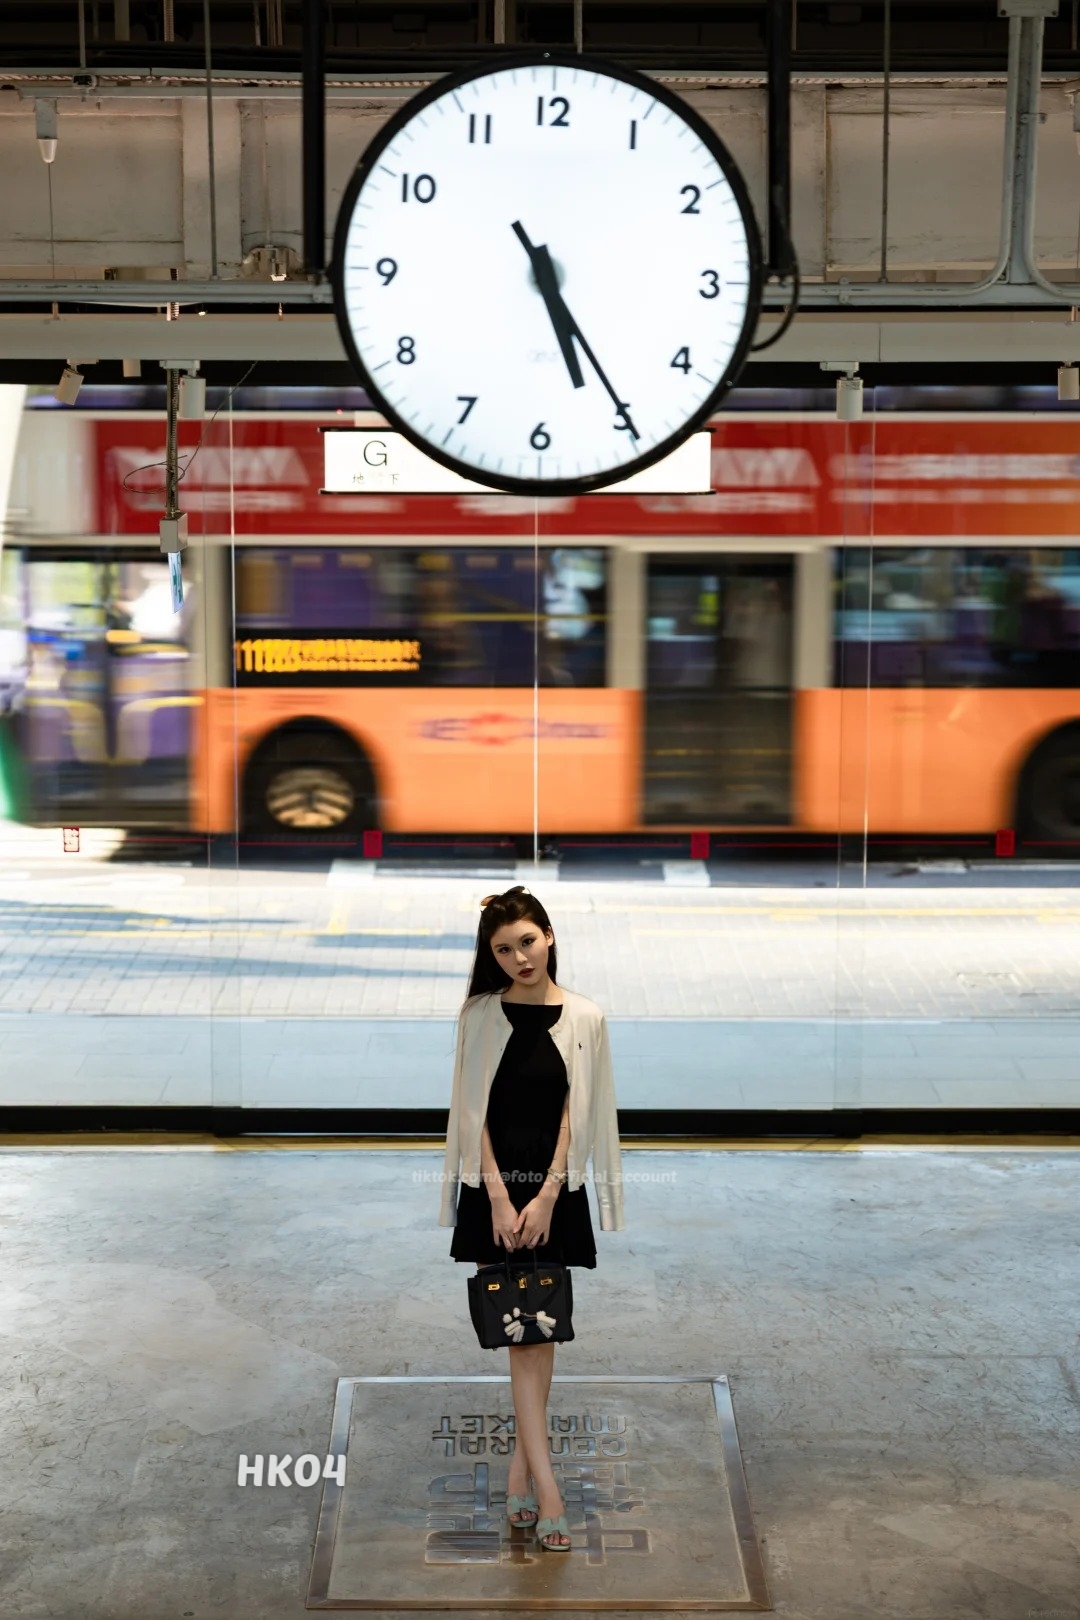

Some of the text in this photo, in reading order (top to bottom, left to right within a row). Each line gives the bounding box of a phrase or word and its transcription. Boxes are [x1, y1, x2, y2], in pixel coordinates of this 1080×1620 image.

[538, 97, 570, 127] 12
[469, 114, 492, 144] 11
[630, 120, 637, 149] 1
[402, 174, 436, 204] 10
[680, 185, 701, 214] 2
[376, 258, 398, 286] 9
[700, 270, 720, 299] 3
[396, 337, 416, 365] 8
[670, 347, 692, 374] 4
[457, 397, 478, 424] 7
[529, 423, 551, 451] 6
[362, 440, 388, 467] G
[432, 1415, 627, 1435] MAKET
[432, 1436, 628, 1457] CENRAL
